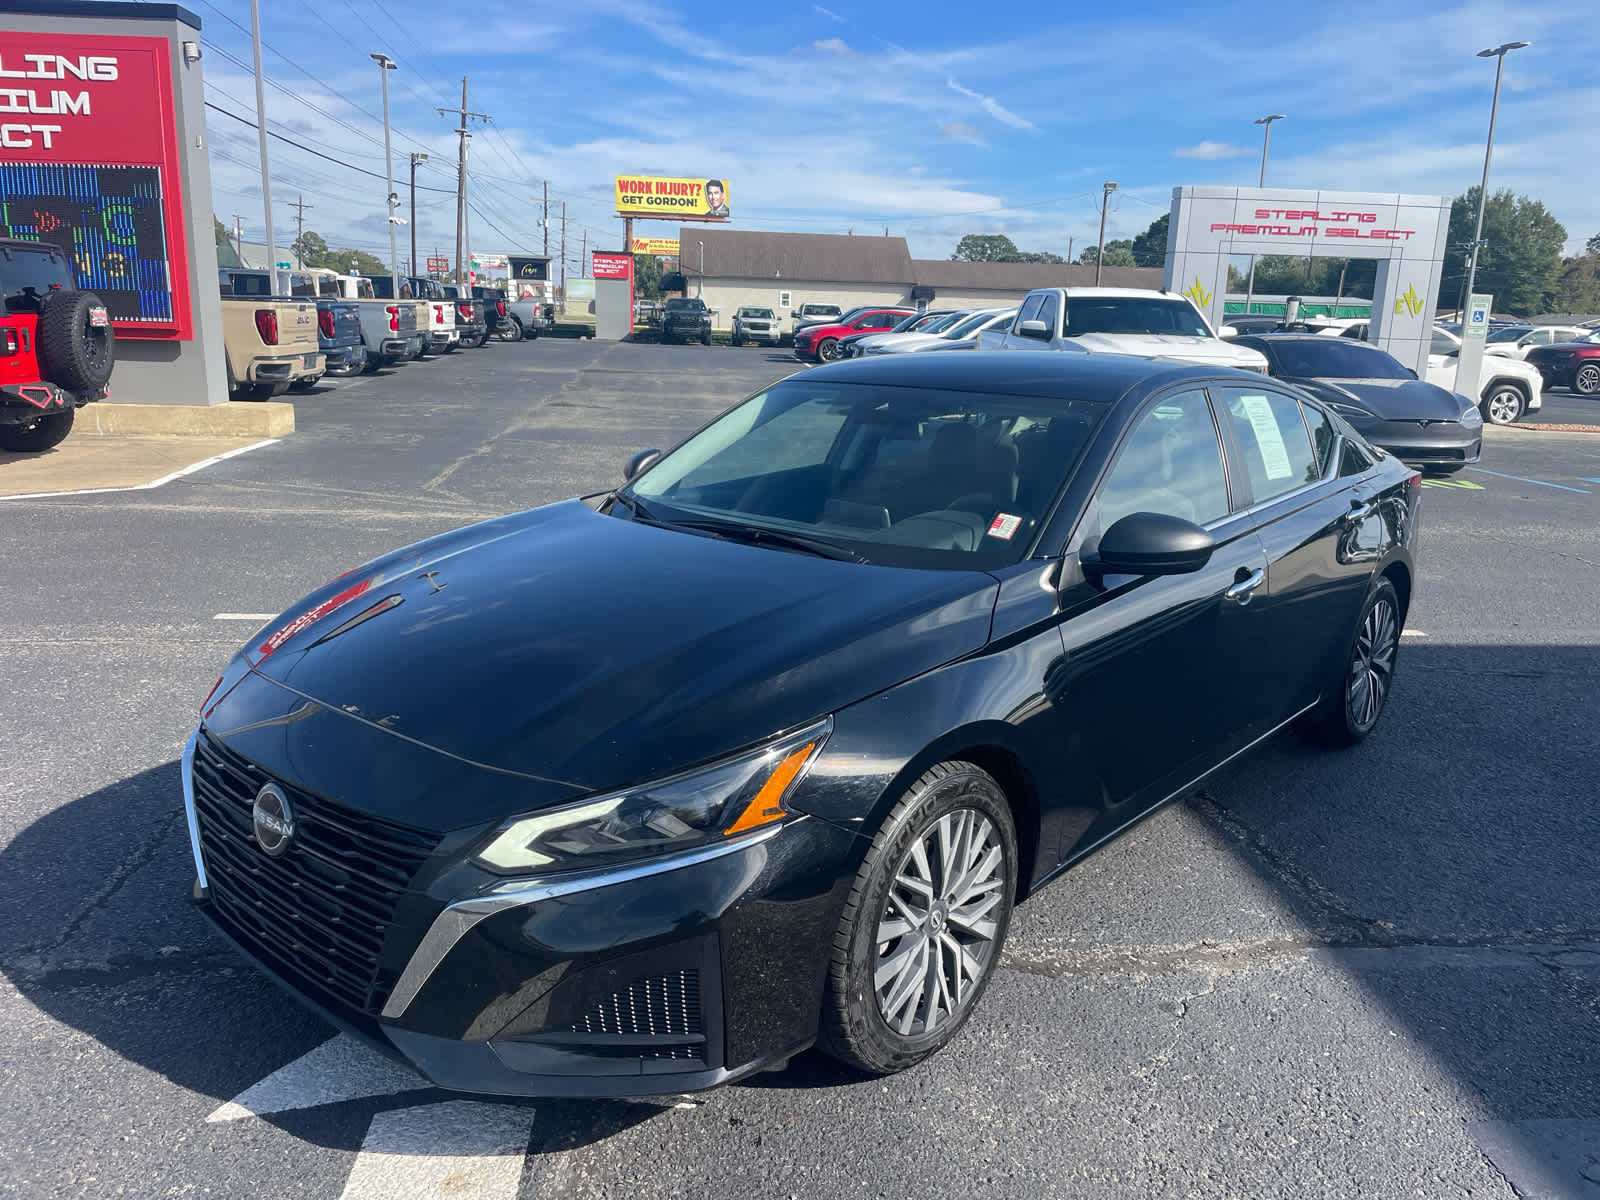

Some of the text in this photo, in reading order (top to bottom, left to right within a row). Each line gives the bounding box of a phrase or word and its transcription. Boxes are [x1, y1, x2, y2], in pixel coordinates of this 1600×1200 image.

[0, 123, 62, 148] CT
[618, 179, 702, 197] WORK INJURY?
[622, 195, 698, 207] GET GORDON!
[1254, 208, 1378, 224] STERLING
[1210, 223, 1417, 241] PREMIUM SELECT
